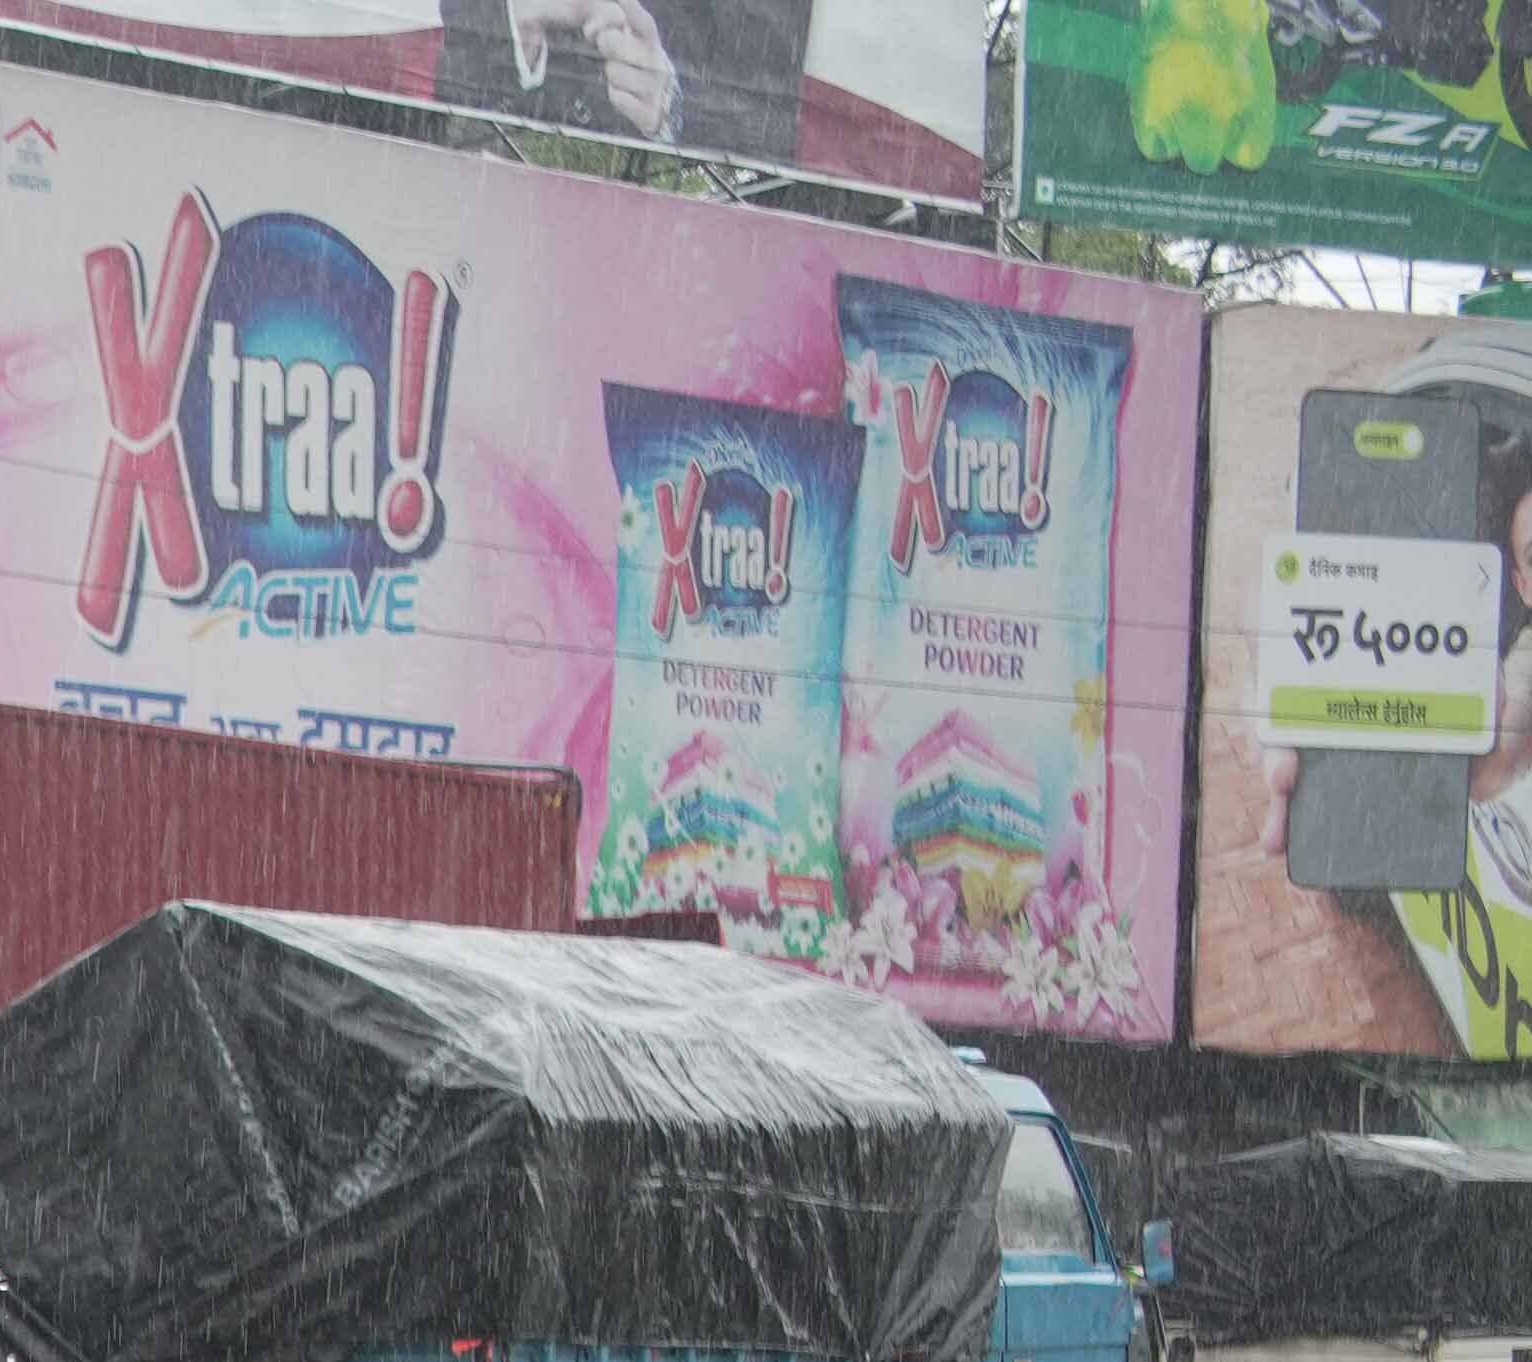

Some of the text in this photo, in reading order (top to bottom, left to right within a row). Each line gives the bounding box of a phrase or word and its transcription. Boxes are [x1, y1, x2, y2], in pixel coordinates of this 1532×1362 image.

[1309, 103, 1448, 146] FZ
[943, 532, 1039, 570] ACTIVE
[210, 562, 422, 641] ACTIVE
[909, 607, 1041, 648] DETERGENT
[1353, 609, 1470, 667] ५०००
[663, 660, 778, 697] DETERGENT
[924, 644, 1026, 682] POWDER
[676, 691, 762, 725] POWDER
